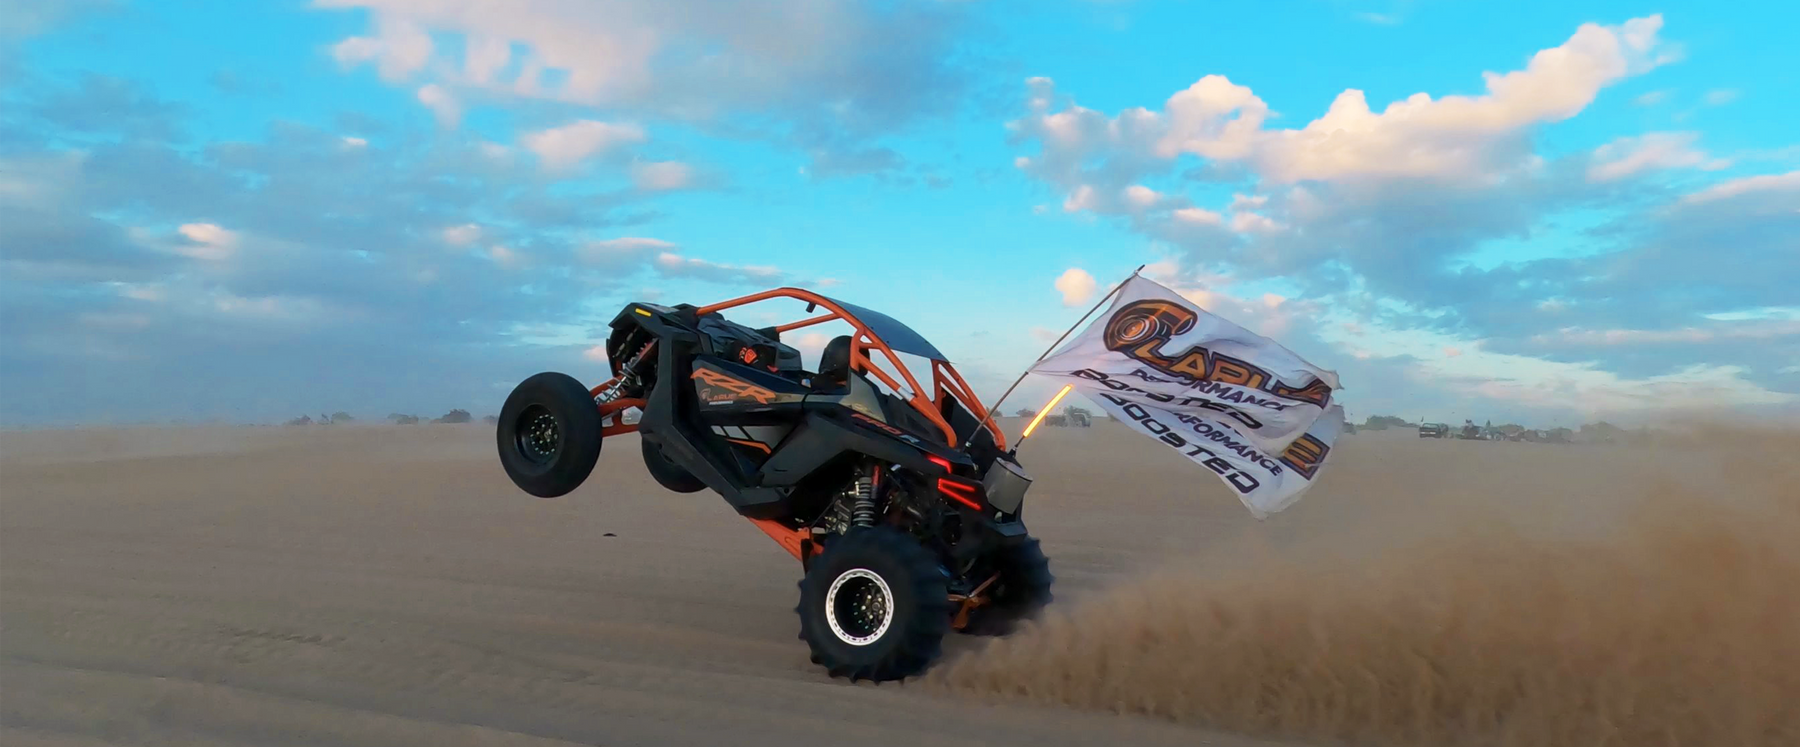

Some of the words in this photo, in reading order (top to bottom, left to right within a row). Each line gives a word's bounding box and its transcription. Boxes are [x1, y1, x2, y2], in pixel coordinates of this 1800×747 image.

[690, 368, 776, 404] RZR
[1129, 368, 1284, 411] PORMANC
[1173, 412, 1282, 476] FORMANCE
